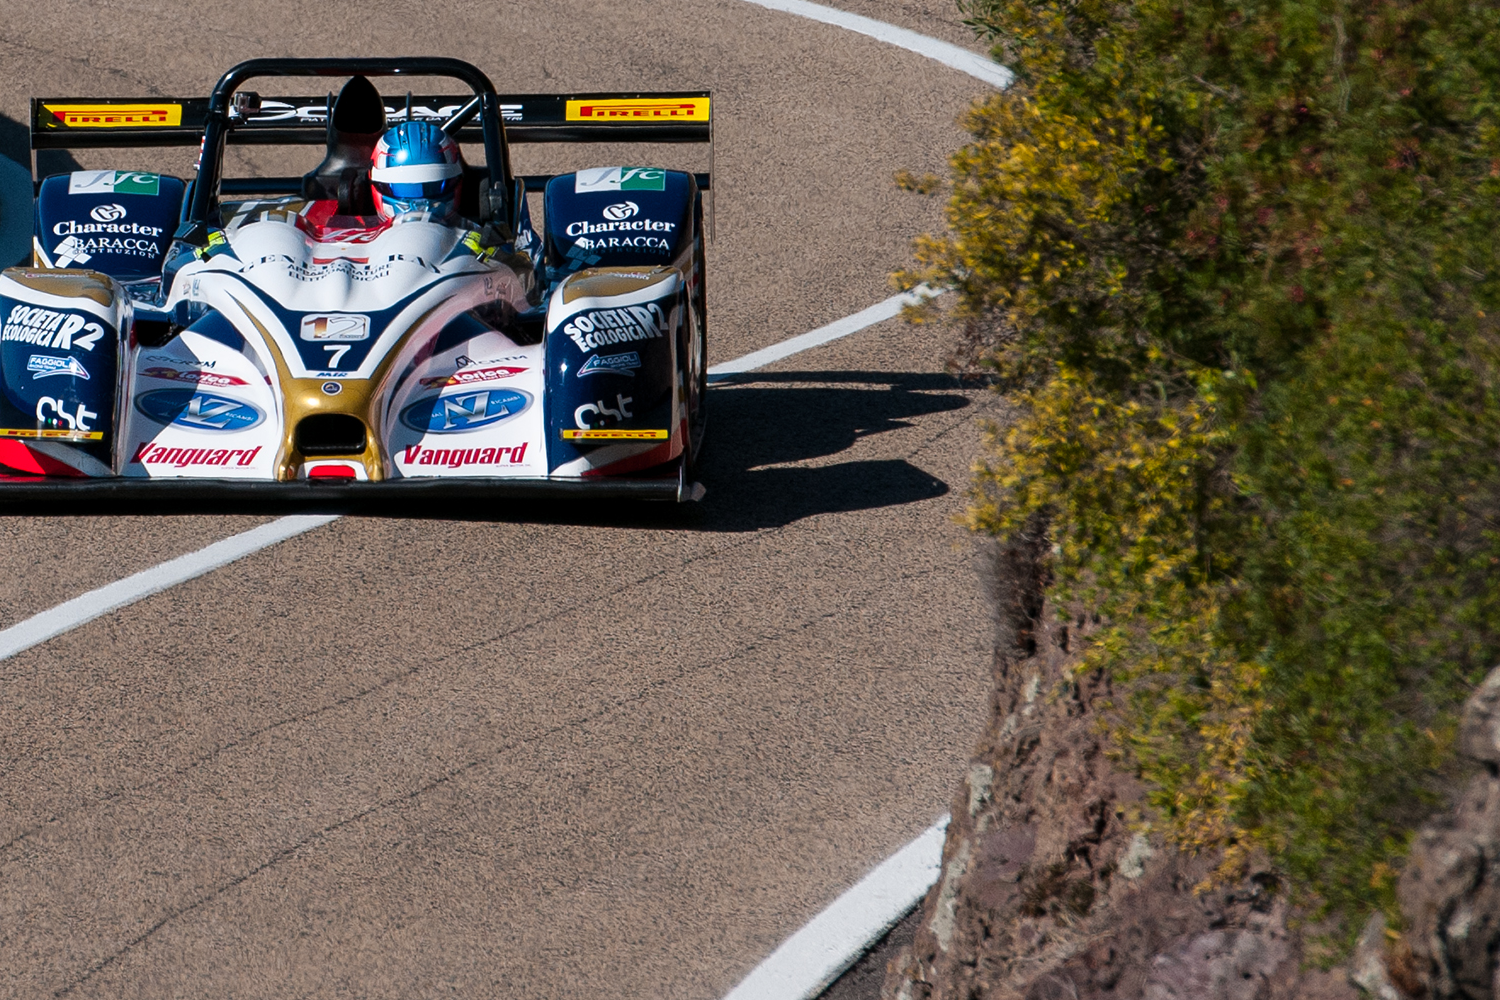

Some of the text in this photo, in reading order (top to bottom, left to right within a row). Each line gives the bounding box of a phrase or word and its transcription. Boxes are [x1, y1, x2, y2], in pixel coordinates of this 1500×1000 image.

[53, 109, 168, 123] PIRELLI
[580, 103, 696, 117] PIRELLI
[53, 220, 163, 237] Character
[566, 218, 676, 236] Character
[73, 237, 160, 255] BARACCA
[585, 236, 670, 250] BARACCA
[629, 303, 669, 340] R2
[2, 324, 55, 347] ECOLOGICA
[51, 314, 105, 352] R2
[574, 325, 648, 353] ECOLOGICA
[323, 345, 352, 369] 7
[593, 354, 638, 367] FAGGIOLI
[490, 395, 521, 405] RICAMBI
[225, 411, 254, 421] RICAMBI
[130, 442, 263, 468] Vanguard
[403, 441, 529, 469] Vanguard
